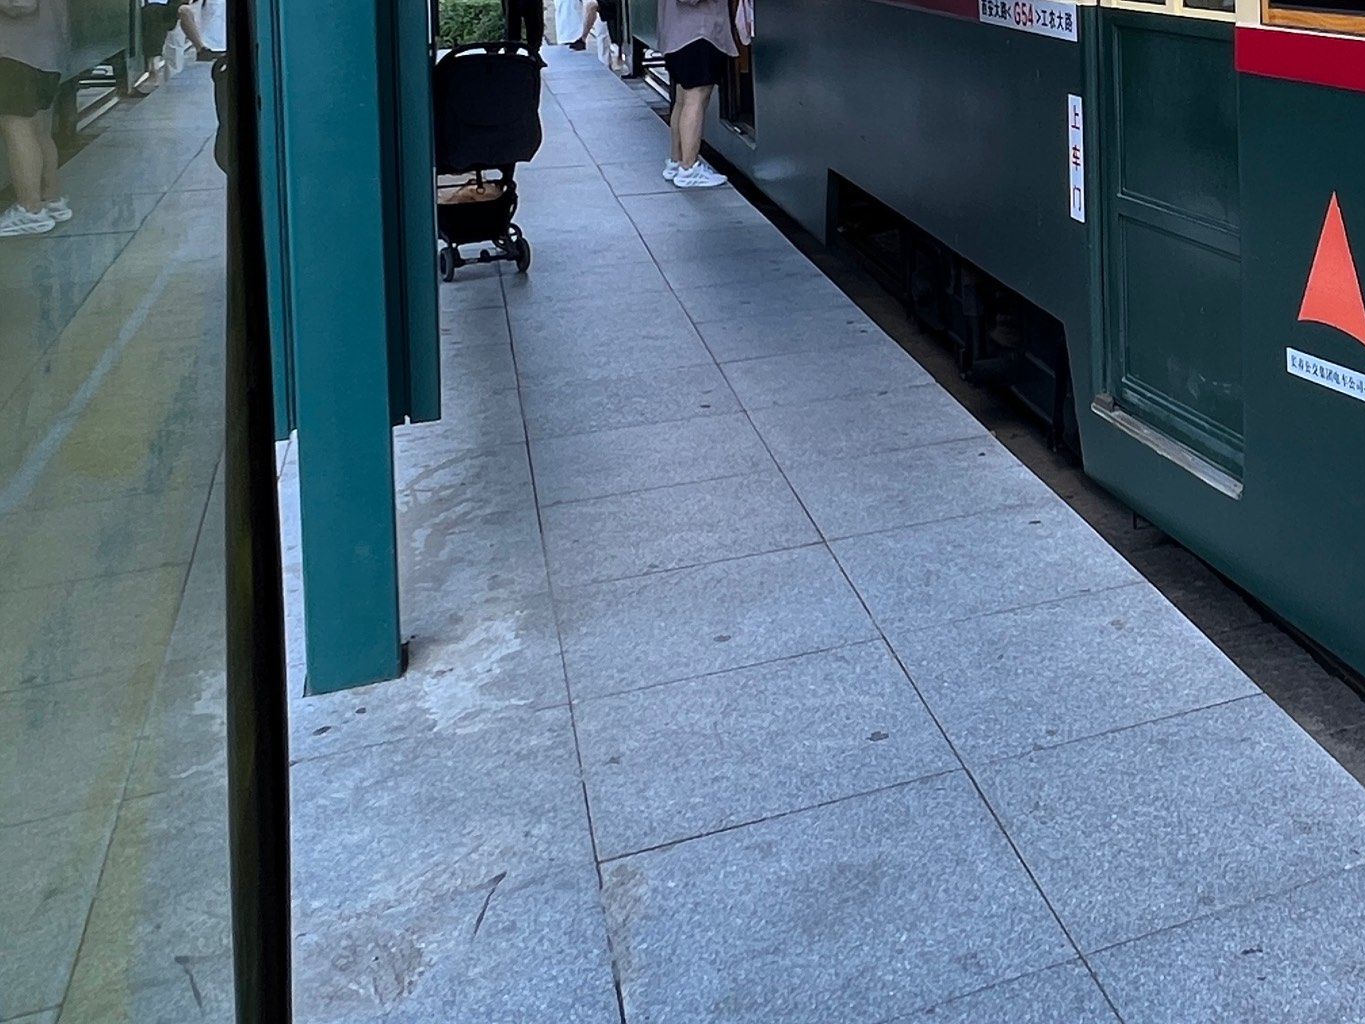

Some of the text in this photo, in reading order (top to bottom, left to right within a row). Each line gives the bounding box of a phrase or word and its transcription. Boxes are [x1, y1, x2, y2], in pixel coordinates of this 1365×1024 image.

[1013, 1, 1034, 27] G54
[1071, 104, 1082, 213] 上车门
